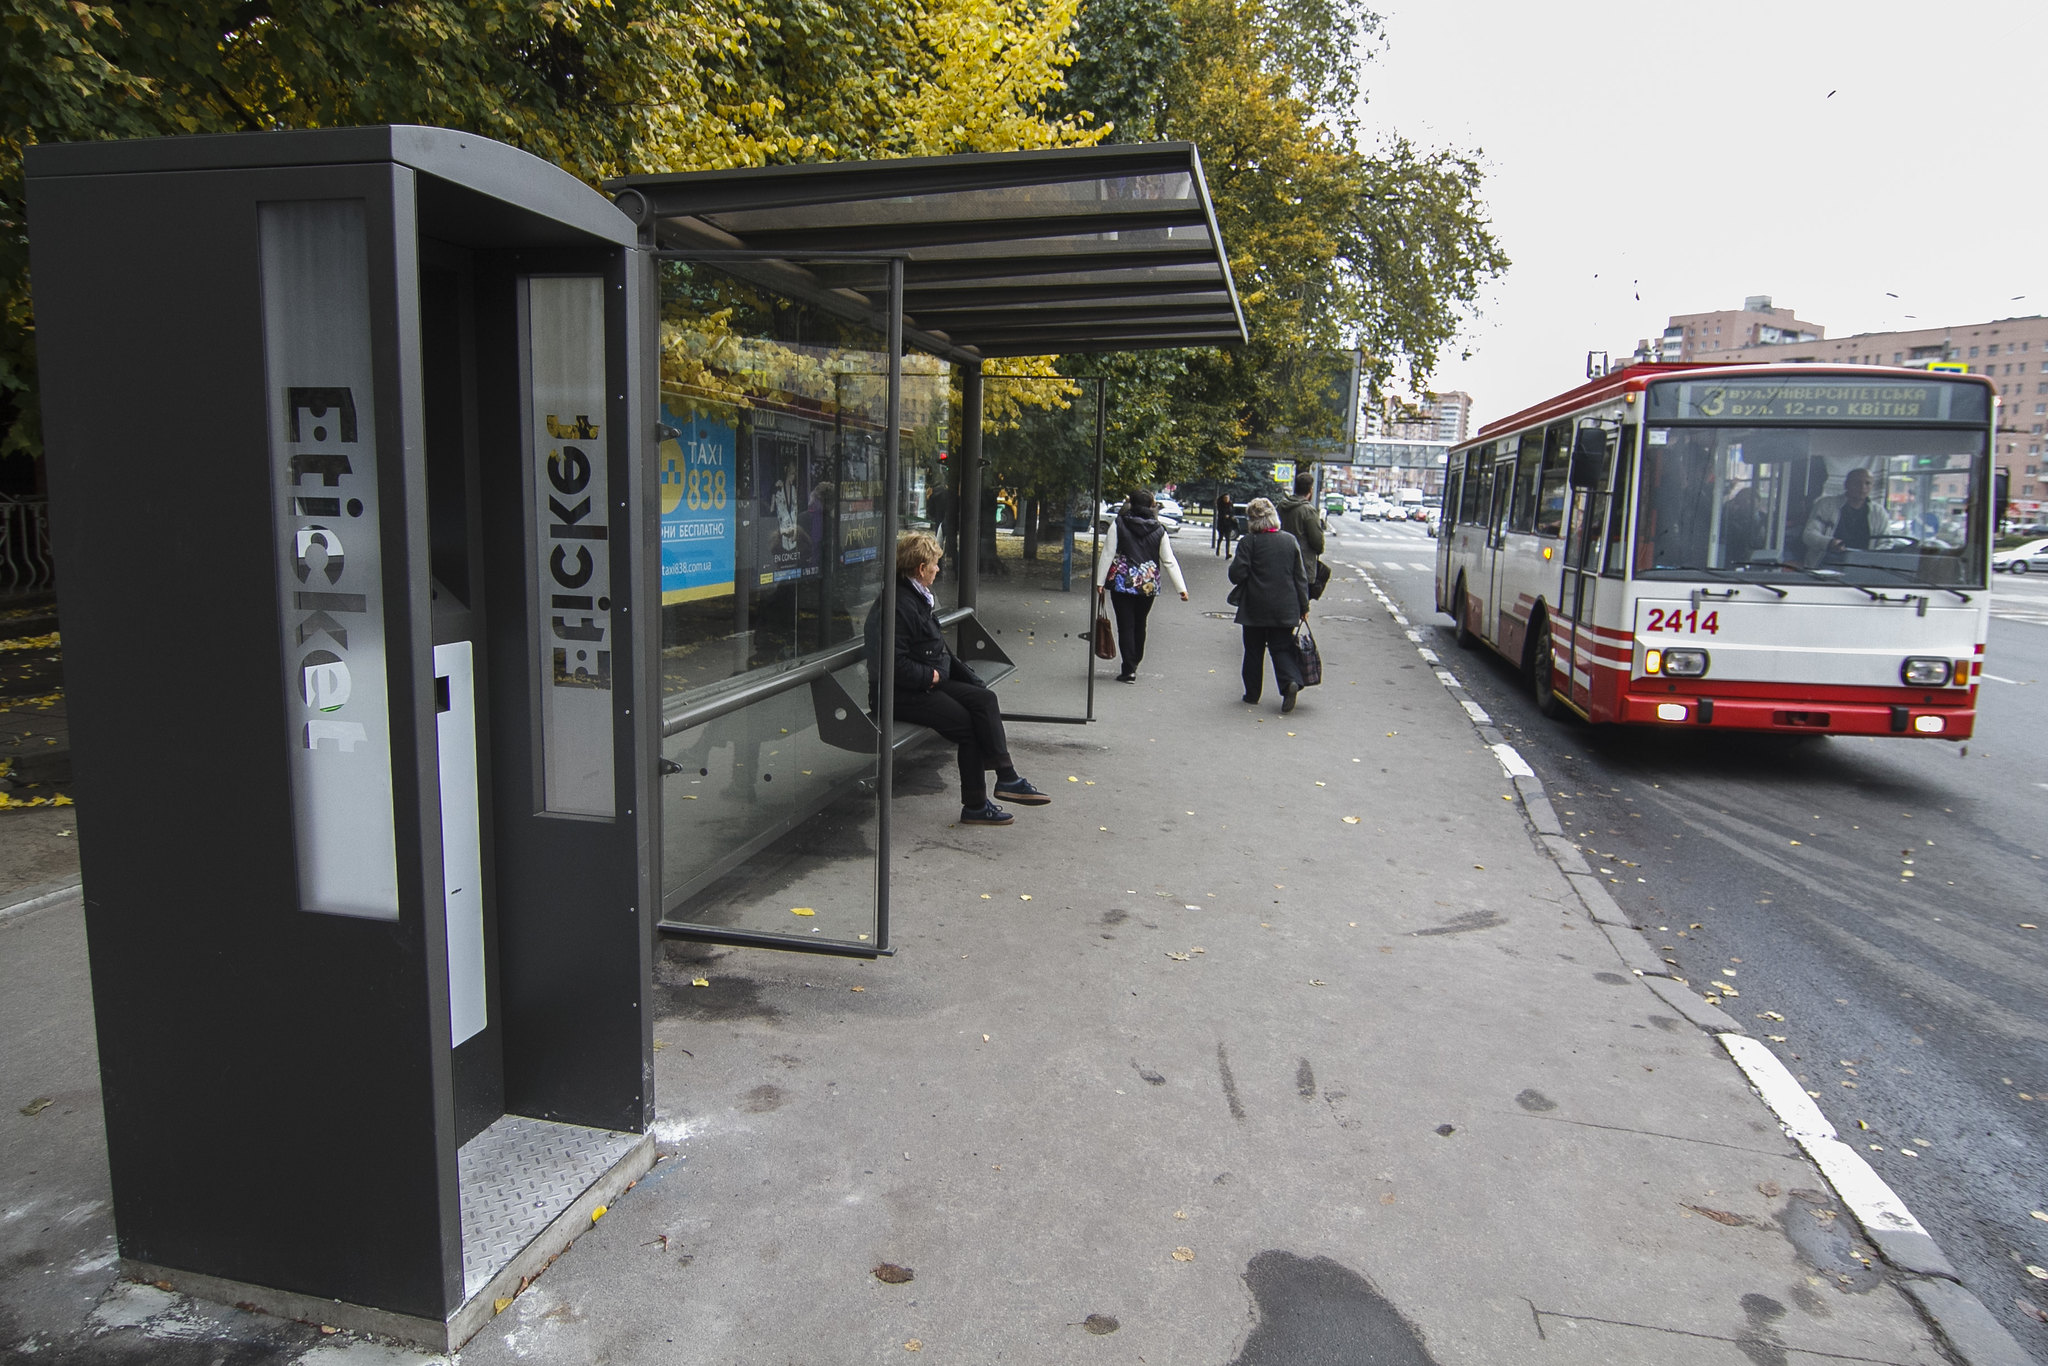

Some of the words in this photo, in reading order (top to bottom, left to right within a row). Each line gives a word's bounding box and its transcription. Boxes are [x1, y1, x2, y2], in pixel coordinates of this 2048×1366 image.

[1701, 387, 1726, 416] 3
[1732, 404, 1773, 416] вул.
[1784, 402, 1839, 415] 12-го
[688, 441, 723, 466] TAXI
[687, 469, 727, 511] 838
[679, 522, 724, 538] БЕСПЛАТНО
[1647, 608, 1719, 635] 2414
